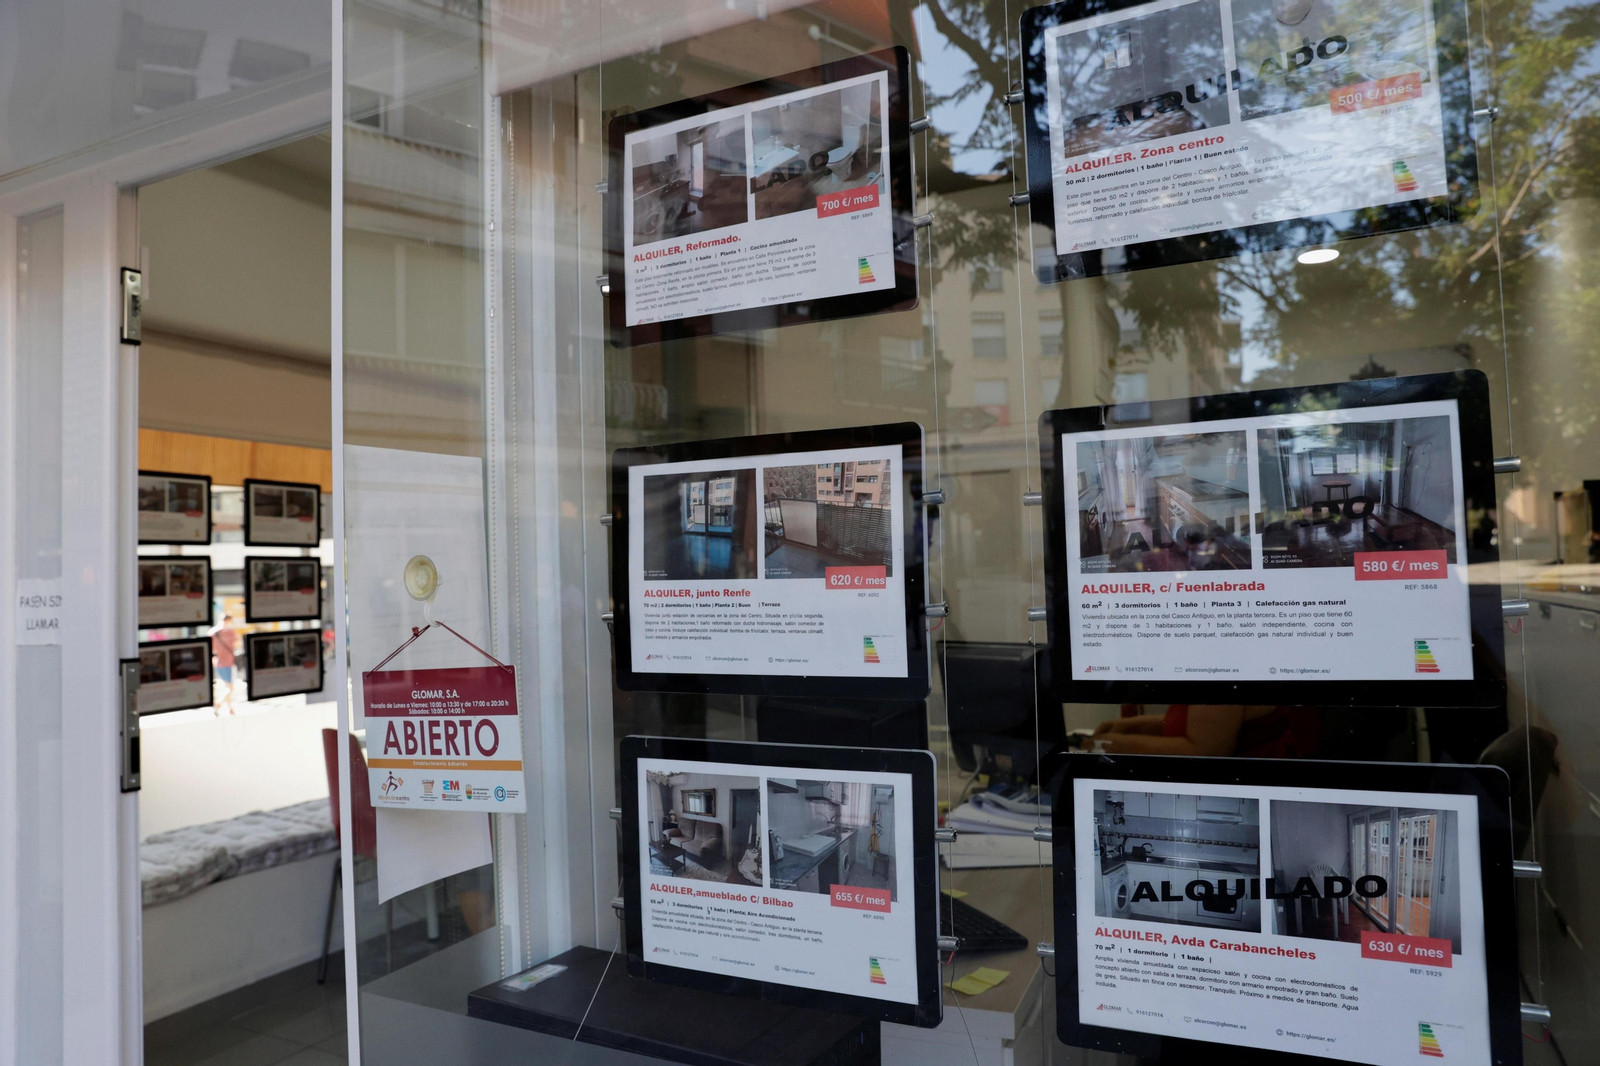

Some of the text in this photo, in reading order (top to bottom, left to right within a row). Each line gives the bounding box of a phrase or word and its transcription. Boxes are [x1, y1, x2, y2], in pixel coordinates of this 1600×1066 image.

[1338, 84, 1412, 106] 500 €/ mes
[1065, 136, 1224, 174] ALQUILER. Zona centro
[1096, 168, 1134, 179] dormitorios
[1224, 146, 1248, 154] estado
[822, 194, 873, 211] 700 €/ mes
[633, 235, 740, 262] ALQUILER, Reformado.
[1362, 560, 1438, 572] 580 €/ mes
[830, 574, 850, 585] 620
[854, 576, 863, 585] €/
[1081, 580, 1265, 595] ALQUILER, c/ Fuenlabrada
[20, 596, 47, 608] PASEN
[644, 588, 750, 599] ALQUILER, junto Renfe
[26, 618, 60, 630] LLAMAR
[411, 689, 459, 699] GLOMAR, S.A.
[382, 718, 499, 756] ABIERTO
[1130, 875, 1388, 903] ALQUILADO
[835, 891, 885, 906] 655 €/ mes
[1094, 926, 1316, 960] ALQUILER, Avda Carabancheles
[1368, 940, 1443, 958] 630 €/ mes
[1133, 948, 1168, 958] dormitorio
[1094, 954, 1113, 962] Amplia
[1290, 978, 1345, 990] electrodomésticos
[1135, 1009, 1162, 1017] 916127014
[1194, 1018, 1246, 1029] alcorcon@glomar.es
[1286, 1030, 1336, 1042] https://glomar.es/
